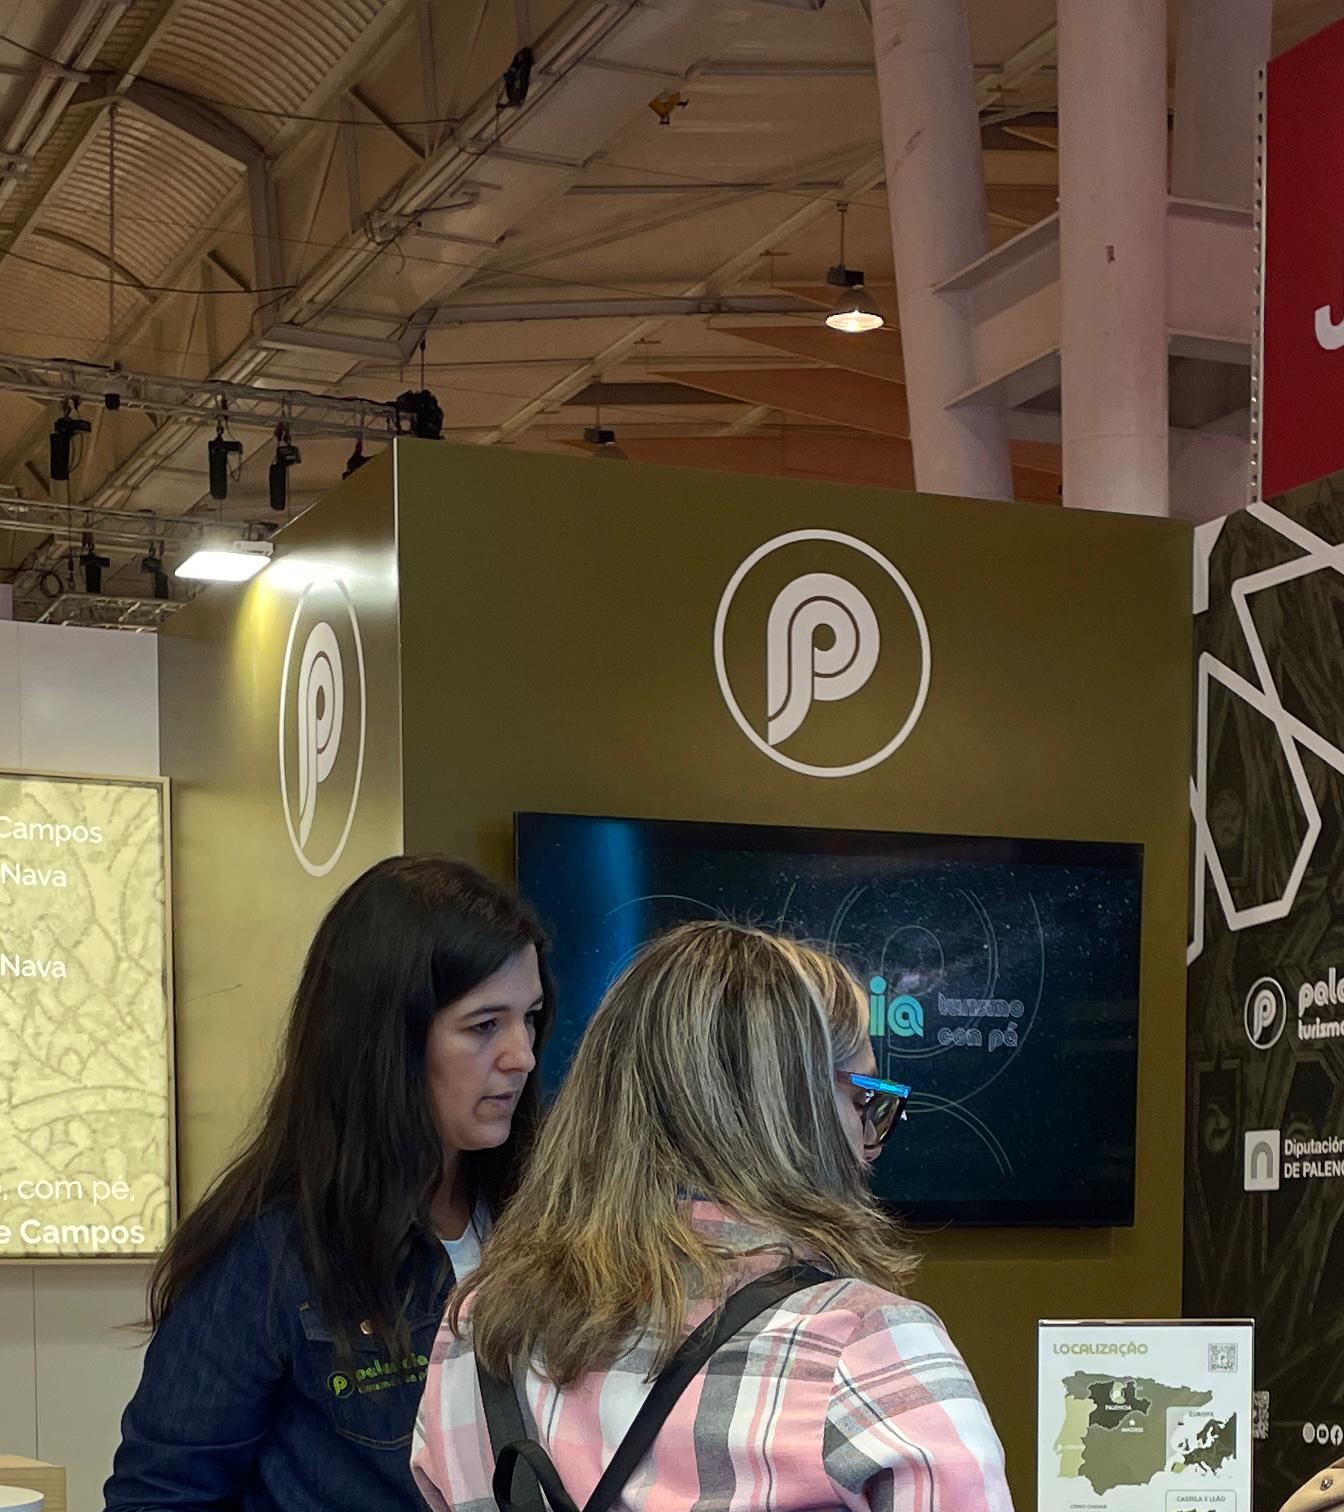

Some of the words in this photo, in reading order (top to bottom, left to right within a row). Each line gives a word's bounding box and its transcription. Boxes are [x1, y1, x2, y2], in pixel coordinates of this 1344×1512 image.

[1, 863, 67, 887] Nava
[0, 956, 67, 978] Nava
[1284, 1161, 1300, 1179] DE
[17, 1178, 83, 1199] com
[92, 1175, 135, 1206] pé,
[20, 1218, 145, 1250] Campos
[1053, 1341, 1148, 1358] LOCALIZAÇÃO
